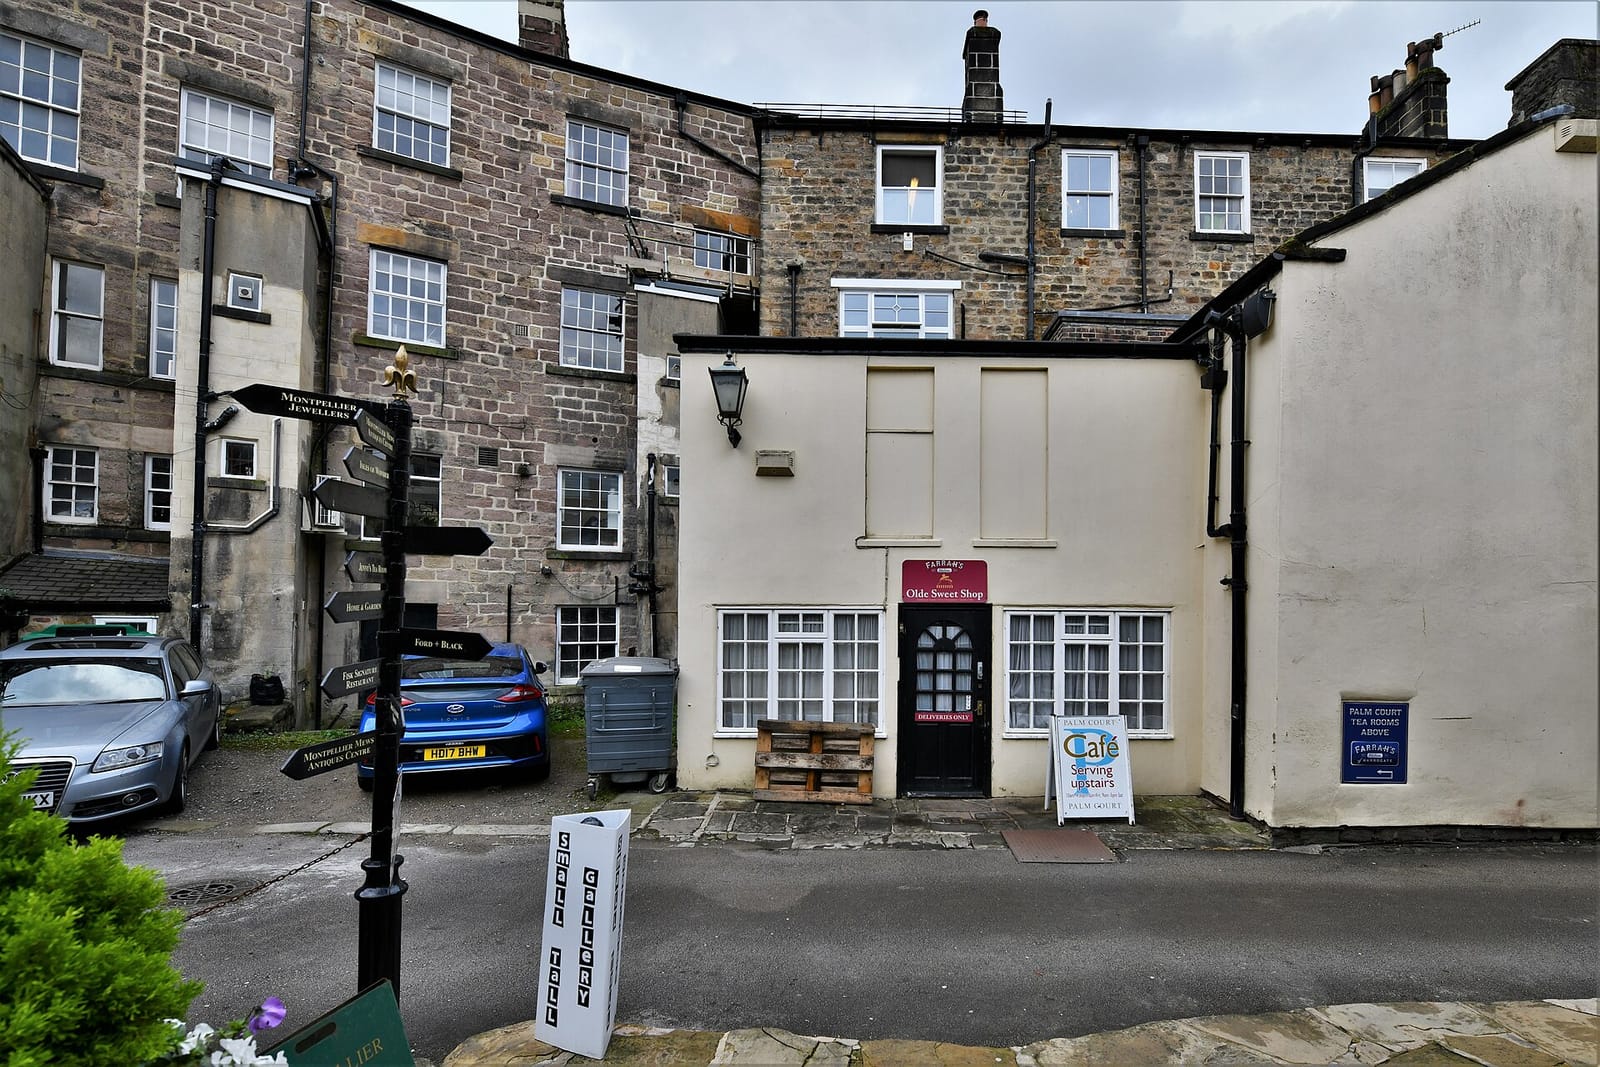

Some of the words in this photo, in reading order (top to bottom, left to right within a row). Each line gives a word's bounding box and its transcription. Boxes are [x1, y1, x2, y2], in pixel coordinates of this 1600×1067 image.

[281, 392, 357, 412] MONTPELLIER
[288, 403, 350, 419] JEWELLERS
[925, 560, 964, 569] FARRAH'S
[906, 588, 929, 598] Olde
[931, 588, 958, 598] Sweet
[960, 588, 984, 601] Shop
[415, 638, 433, 648] FORD
[441, 640, 464, 650] BLACK
[1349, 707, 1372, 716] PALM
[1374, 708, 1402, 716] COURT
[1351, 718, 1368, 726] TEA
[1370, 718, 1399, 726] ROOMS
[1360, 728, 1389, 736] ABOVE
[304, 743, 353, 763] MONTPELLIER
[355, 737, 375, 749] MEWS
[431, 748, 455, 759] HD17
[458, 745, 479, 757] BHW
[1063, 734, 1119, 758] Café
[1354, 744, 1396, 754] FARRAH'S
[308, 754, 345, 771] ANTIQUES
[345, 747, 372, 760] CENTRE
[1071, 764, 1113, 778] Serving
[1071, 778, 1115, 790] upstairs
